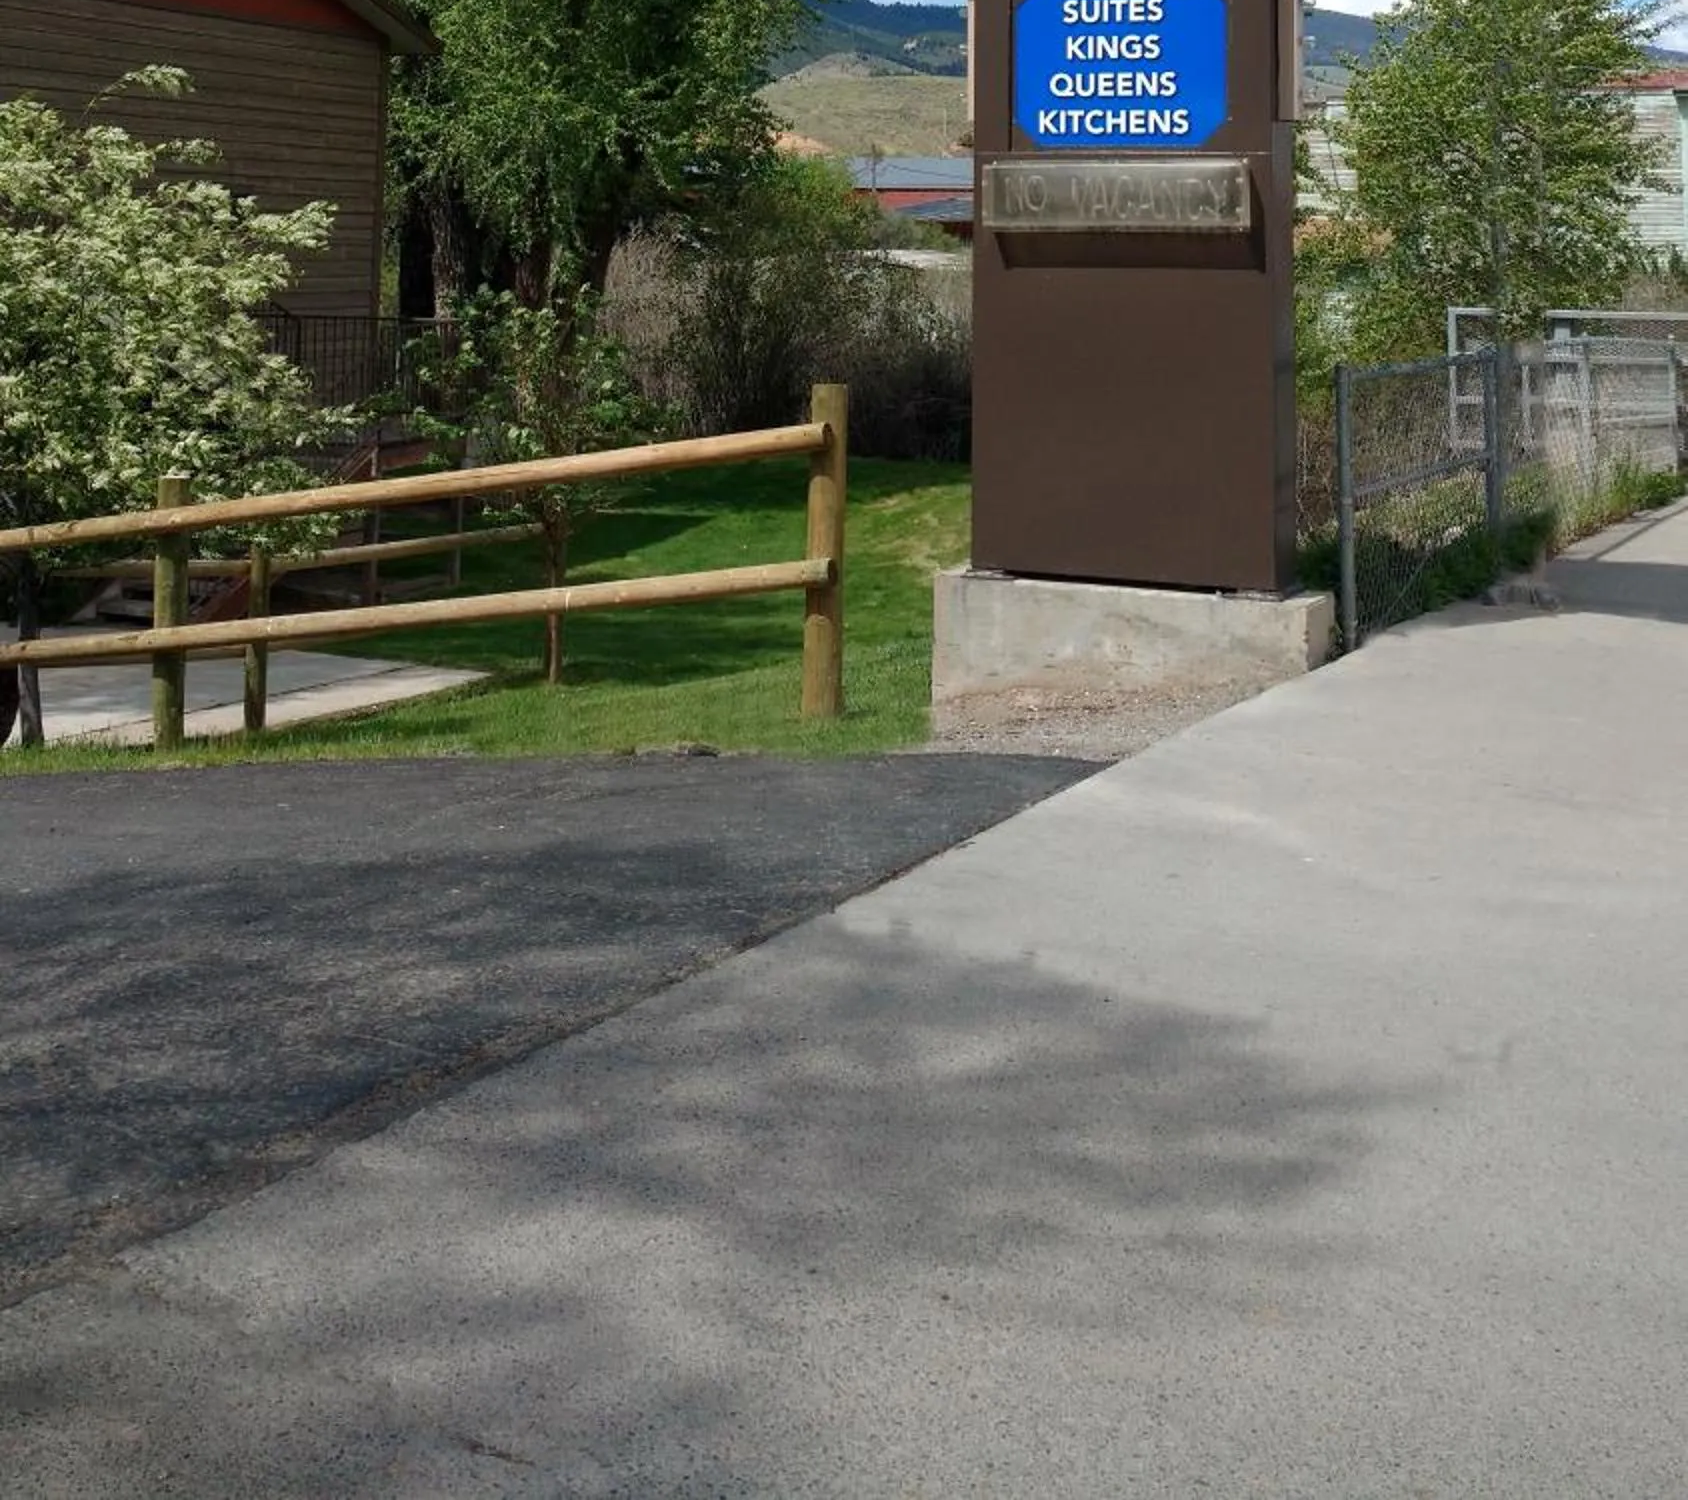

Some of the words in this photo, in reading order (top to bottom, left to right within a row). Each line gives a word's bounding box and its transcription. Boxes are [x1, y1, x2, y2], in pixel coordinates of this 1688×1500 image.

[1065, 34, 1161, 60] KINGS
[1049, 71, 1178, 98] QUEENS
[1038, 109, 1190, 135] KITCHENS
[1003, 174, 1048, 213] NO
[1070, 176, 1228, 222] VACANCY
